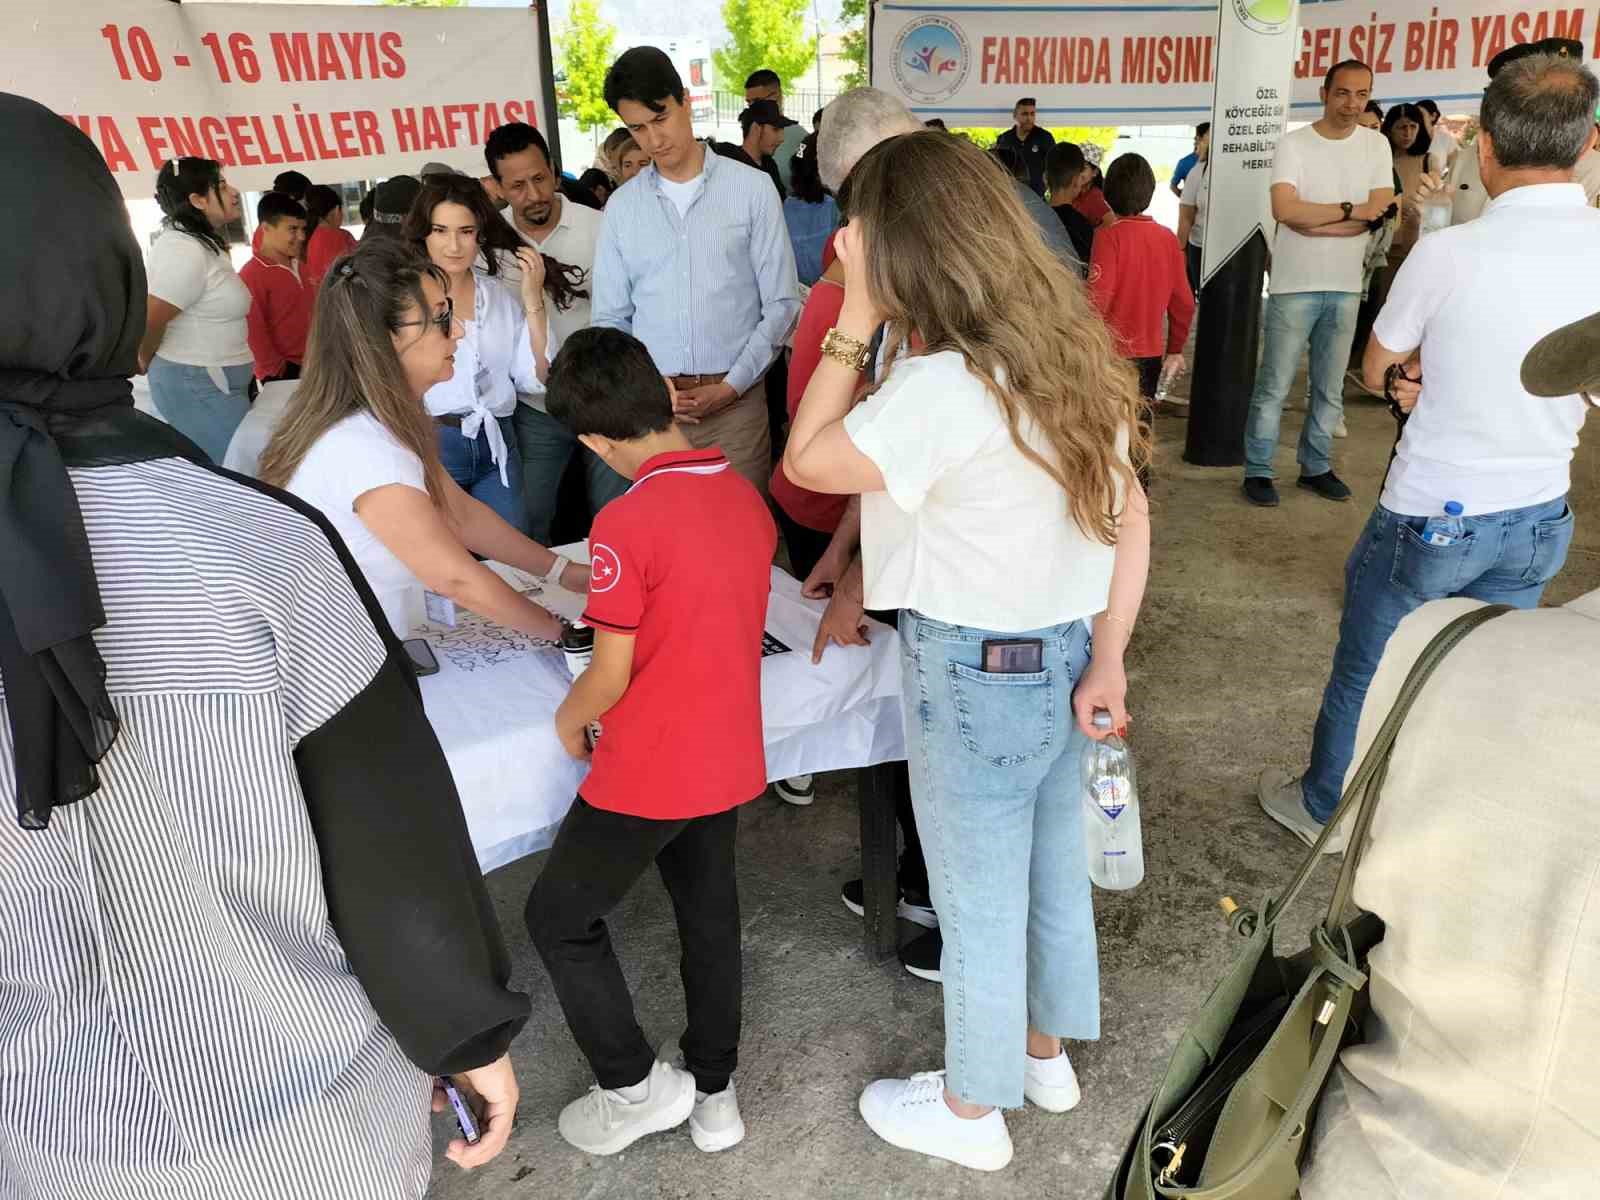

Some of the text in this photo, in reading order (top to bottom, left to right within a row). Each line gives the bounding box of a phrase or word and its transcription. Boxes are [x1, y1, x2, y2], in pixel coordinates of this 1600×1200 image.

[101, 23, 407, 83] 10 - 16 MAYIS
[981, 37, 1112, 84] FARKINDA
[1120, 36, 1215, 84] MISINI
[1404, 7, 1459, 71] BİR
[1224, 104, 1273, 119] KÖYCEĞİZ
[1256, 87, 1278, 99] ÖZEL
[137, 103, 385, 171] ENGELLİLER
[394, 100, 537, 153] HAFTASI
[1228, 123, 1254, 136] ÖZEL
